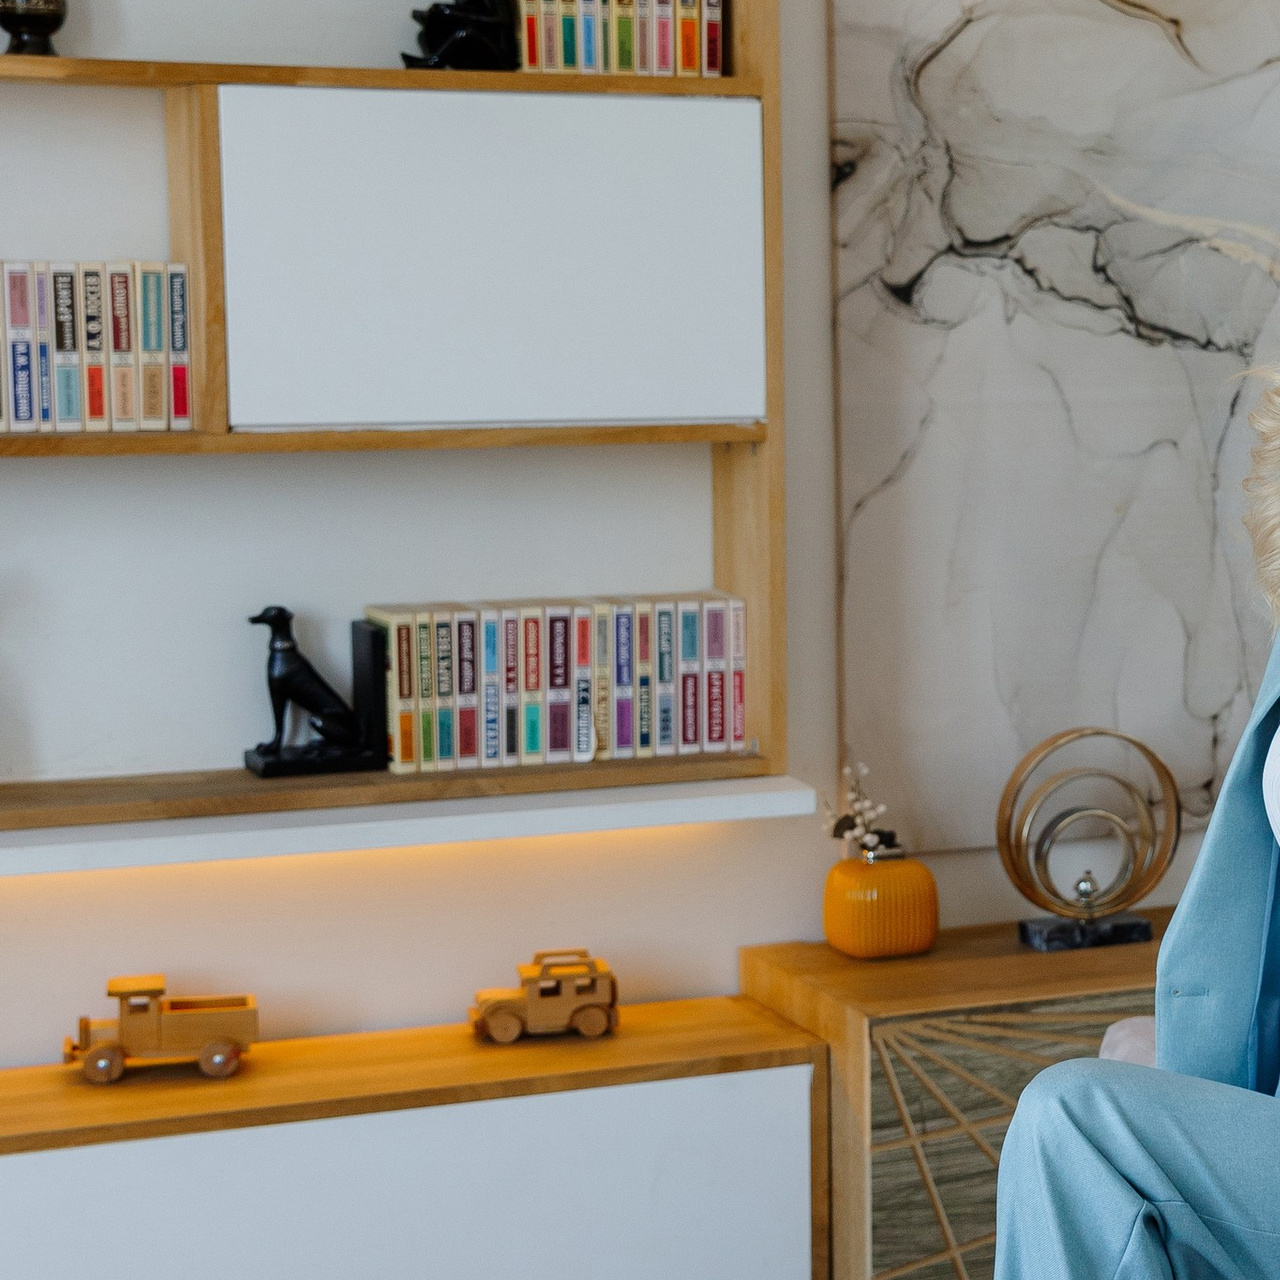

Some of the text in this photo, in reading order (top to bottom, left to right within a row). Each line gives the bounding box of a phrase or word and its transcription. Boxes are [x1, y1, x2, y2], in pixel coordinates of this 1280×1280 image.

[56, 276, 72, 321] БРОНТЕ
[16, 370, 31, 419] ЗОЩЕНКО
[710, 673, 722, 739] АРИСТОТЕЛЬ
